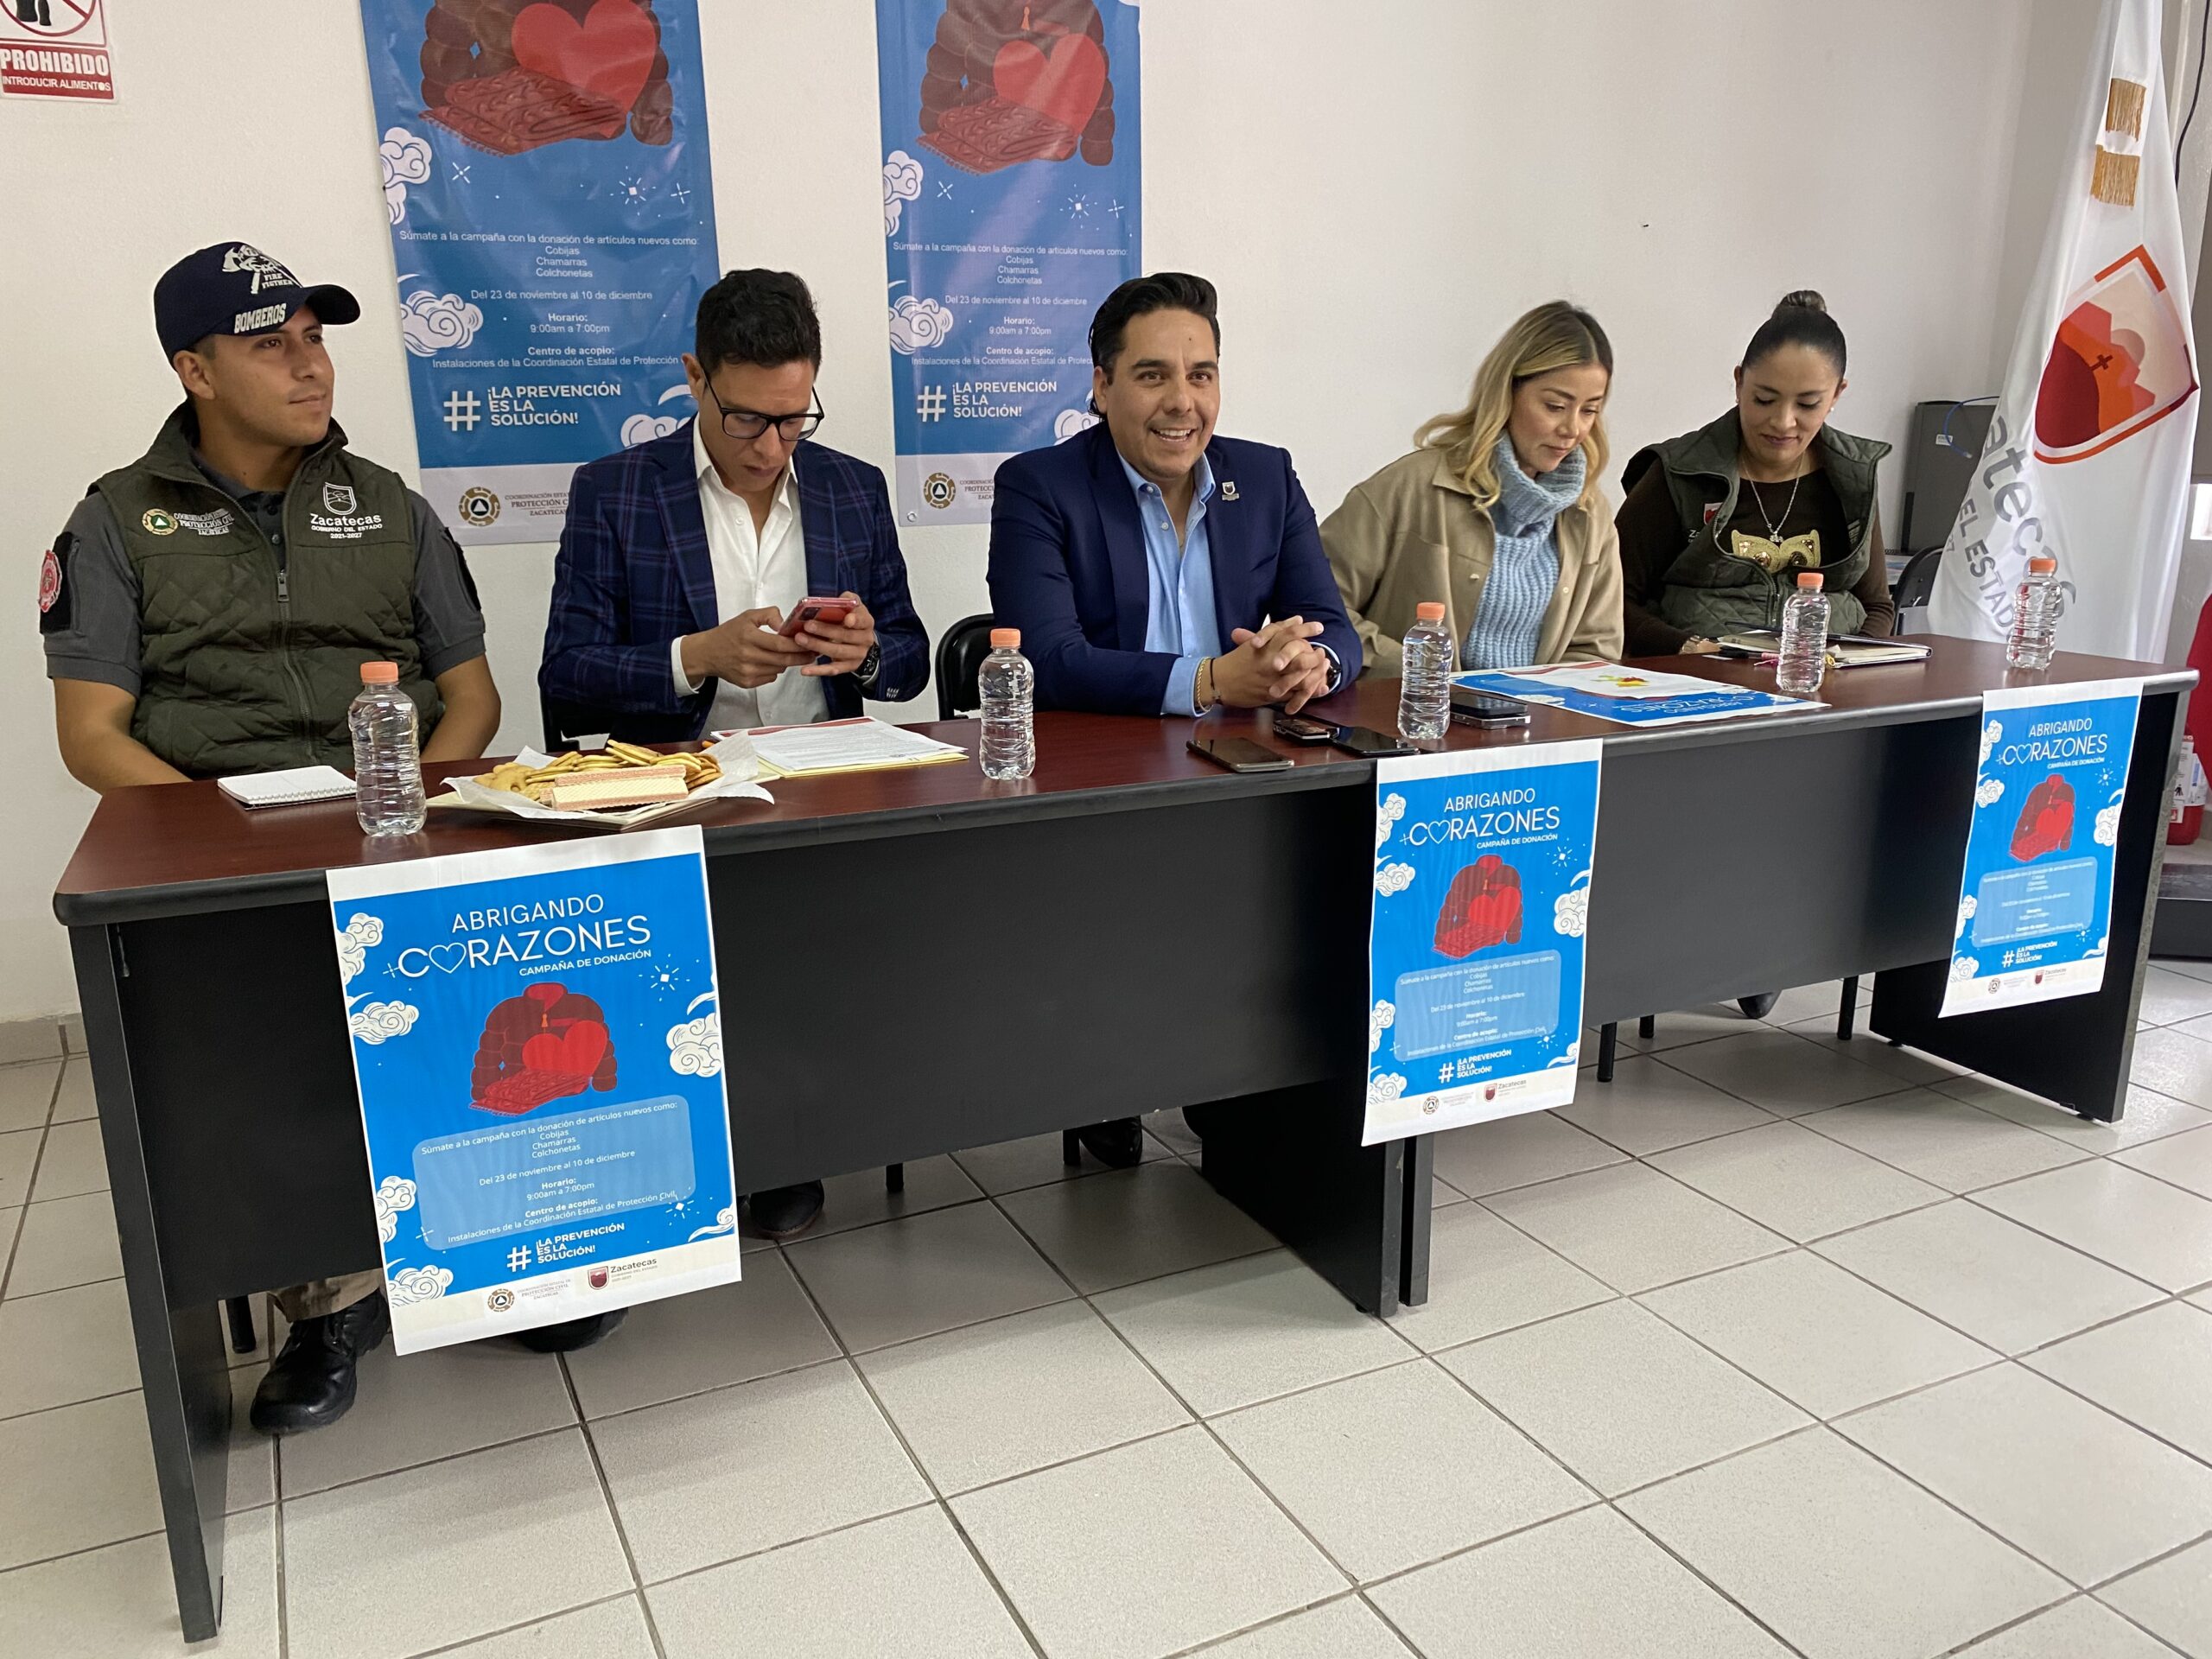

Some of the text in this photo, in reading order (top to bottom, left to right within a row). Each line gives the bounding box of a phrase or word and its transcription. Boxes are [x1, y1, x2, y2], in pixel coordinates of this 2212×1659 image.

[0, 48, 109, 76] PROHIBIDO
[3, 75, 57, 87] INTRODUCIR
[399, 230, 438, 240] Súmate
[449, 231, 459, 241] la
[461, 232, 505, 243] campaña
[527, 234, 537, 243] la
[582, 235, 595, 244] de
[536, 257, 588, 266] Chamarras
[536, 268, 594, 277] Colchonetas
[471, 289, 652, 300] Del 23 de noviembre al 10 de diciembre
[234, 303, 287, 334] BOMBEROS
[528, 346, 562, 355] Centro
[564, 346, 576, 355] de
[432, 359, 496, 368] Instalaciones
[497, 359, 510, 367] de
[512, 358, 521, 367] la
[586, 357, 618, 366] Estatal
[620, 356, 632, 365] de
[516, 383, 621, 398] PREVENCIÓN
[490, 400, 535, 412] ES LA
[491, 410, 578, 426] SOLUCIÓN!
[310, 513, 381, 526] Zacatecas
[1965, 542, 2017, 642] ESTAD
[2029, 718, 2093, 738] ABRIGANDO
[1444, 788, 1535, 812] ABRIGANDO
[452, 894, 604, 933] ABRIGANDO
[519, 950, 652, 976] CAMPAÑA DE DONACIÓN
[422, 1143, 454, 1155] Súmate
[472, 1132, 510, 1145] campaña
[537, 1120, 575, 1133] donación
[588, 1112, 622, 1123] artículos
[624, 1107, 652, 1116] nuevos
[540, 1129, 569, 1141] Cobijas
[532, 1137, 576, 1150] Chamarras
[531, 1144, 581, 1159] Colchonetas
[480, 1177, 493, 1185] Del
[495, 1174, 505, 1183] 23
[518, 1165, 562, 1178] noviembre
[596, 1151, 635, 1163] diciembre
[448, 1227, 501, 1243] Instalaciones
[524, 1211, 576, 1226] Coordinación
[577, 1205, 604, 1216] Estatal
[617, 1195, 658, 1207] Protección
[659, 1191, 676, 1200] Civil
[525, 1207, 554, 1217] Centro
[555, 1223, 625, 1244] PREVENCIÓN
[537, 1243, 567, 1255] ES LA
[537, 1245, 595, 1263] SOLUCIÓN!
[611, 1259, 657, 1274] Zacatecas
